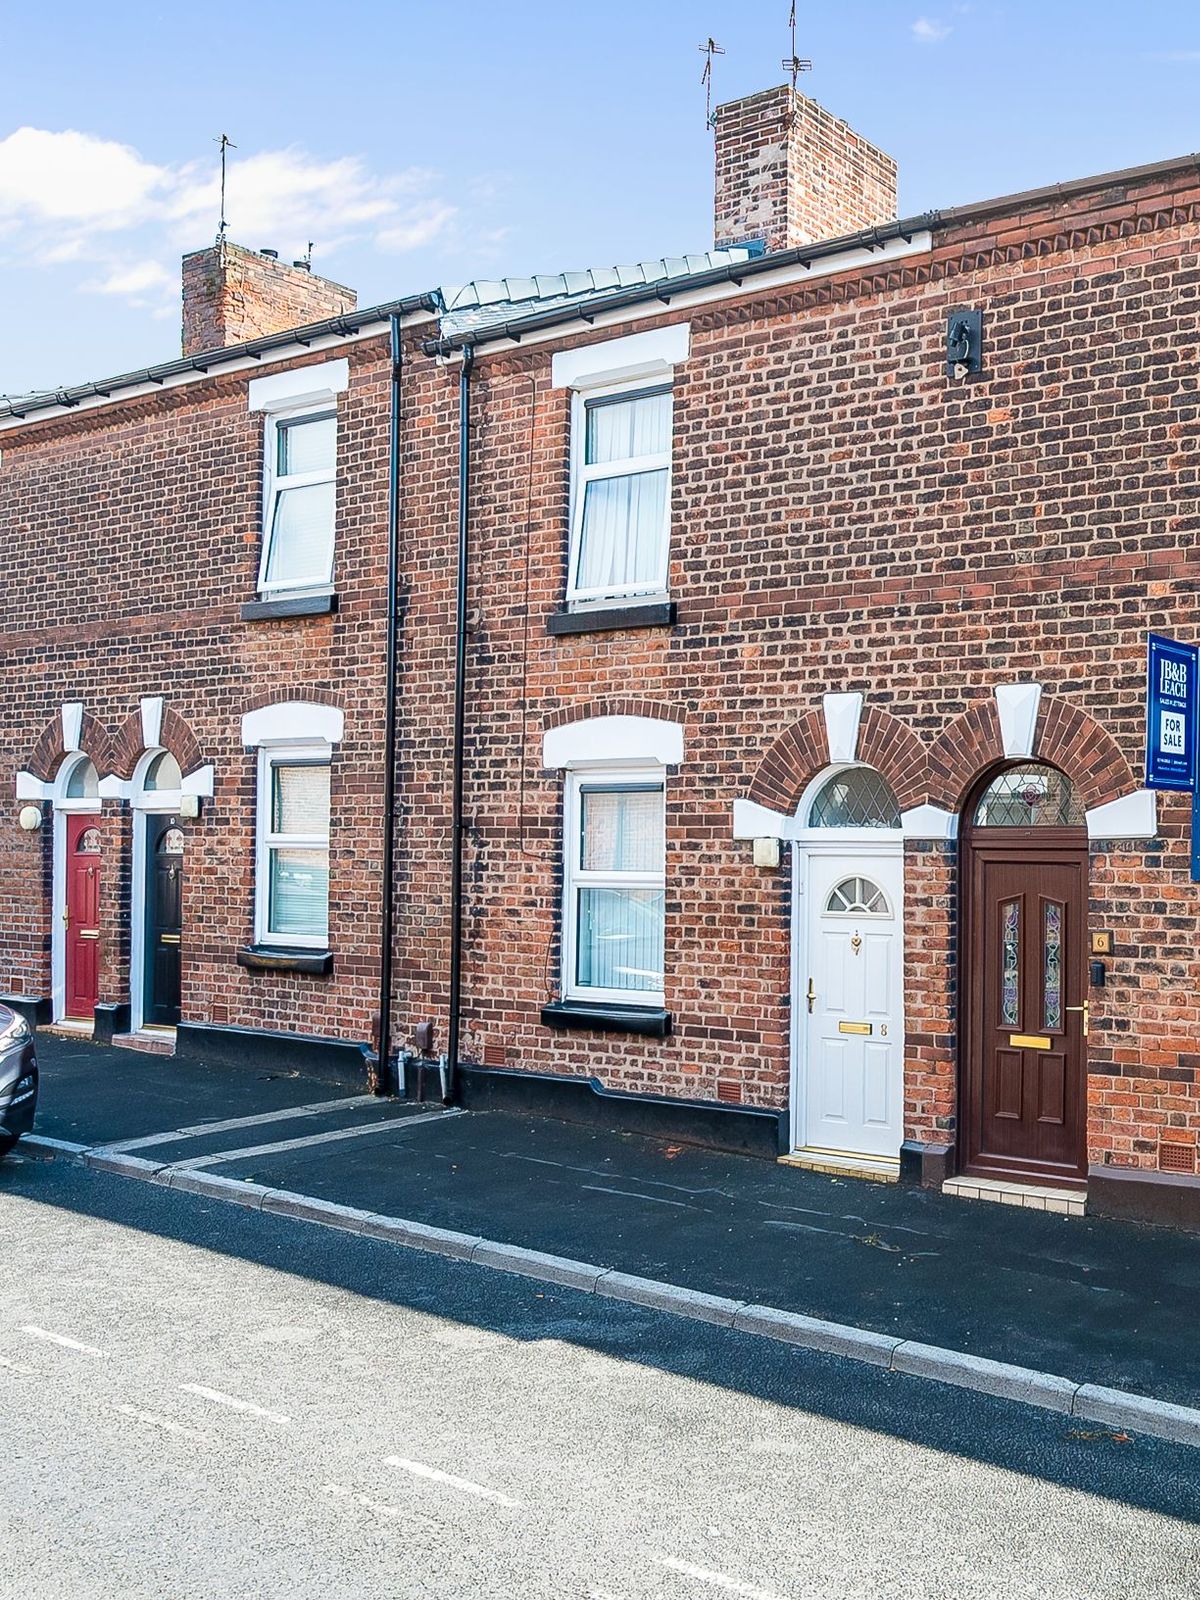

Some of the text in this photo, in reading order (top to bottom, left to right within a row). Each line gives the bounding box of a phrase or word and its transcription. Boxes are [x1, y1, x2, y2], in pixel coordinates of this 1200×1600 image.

[1160, 658, 1187, 683] JB&B
[1160, 678, 1187, 698] LEACH
[1165, 718, 1181, 733] FOR
[1163, 733, 1182, 747] SALE
[1097, 936, 1104, 948] 6
[880, 1023, 888, 1036] 8
